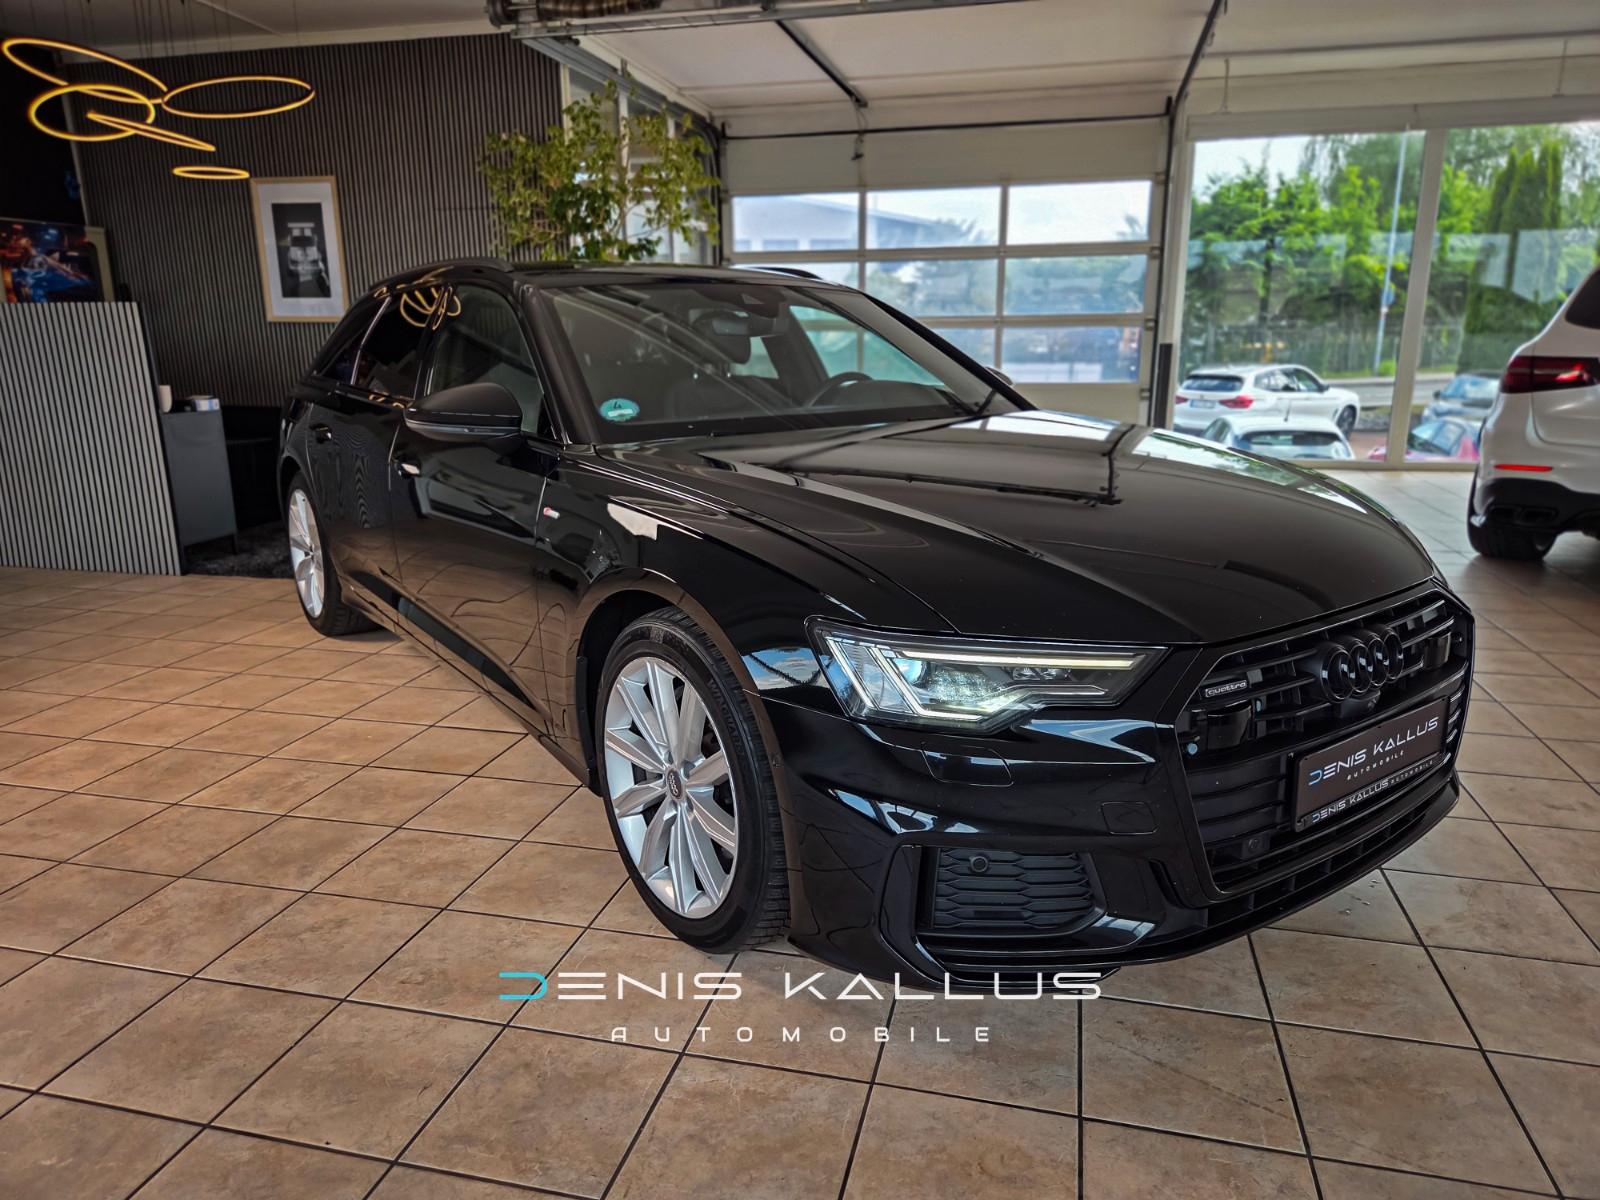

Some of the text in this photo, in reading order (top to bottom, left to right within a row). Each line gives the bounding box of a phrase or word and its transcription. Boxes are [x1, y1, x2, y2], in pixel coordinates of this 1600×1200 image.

[1308, 716, 1439, 786] DENIS KALLUS
[1347, 750, 1404, 781] AUTOMOBILE
[1312, 800, 1346, 823] DENIS
[1349, 779, 1389, 804] KALLUS
